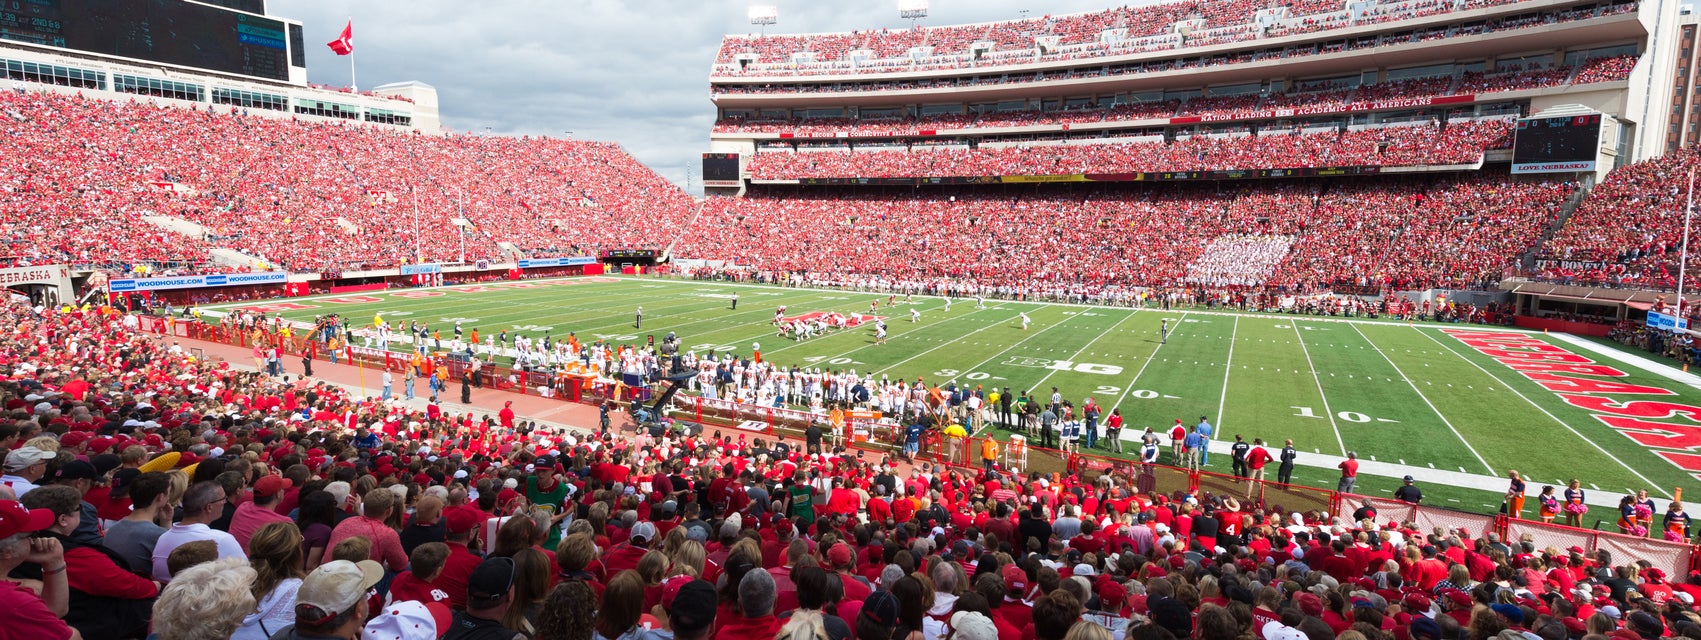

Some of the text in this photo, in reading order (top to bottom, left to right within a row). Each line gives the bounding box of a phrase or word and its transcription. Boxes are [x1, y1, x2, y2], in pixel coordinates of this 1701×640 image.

[1200, 113, 1232, 122] NATION
[1235, 111, 1272, 120] LEADING
[1298, 105, 1347, 115] ACADEMIC
[1351, 102, 1368, 111] ALL
[1373, 98, 1432, 109] AMERICANS
[1518, 163, 1540, 171] LOVE
[137, 278, 203, 288] WOODHOUSE.COM
[229, 274, 285, 282] WOODHOUSE.COM
[803, 355, 853, 365] 40
[934, 368, 991, 381] 30
[1092, 385, 1159, 399] 20
[1290, 405, 1371, 423] 10
[1051, 486, 1060, 496] 7
[1226, 523, 1236, 536] 4
